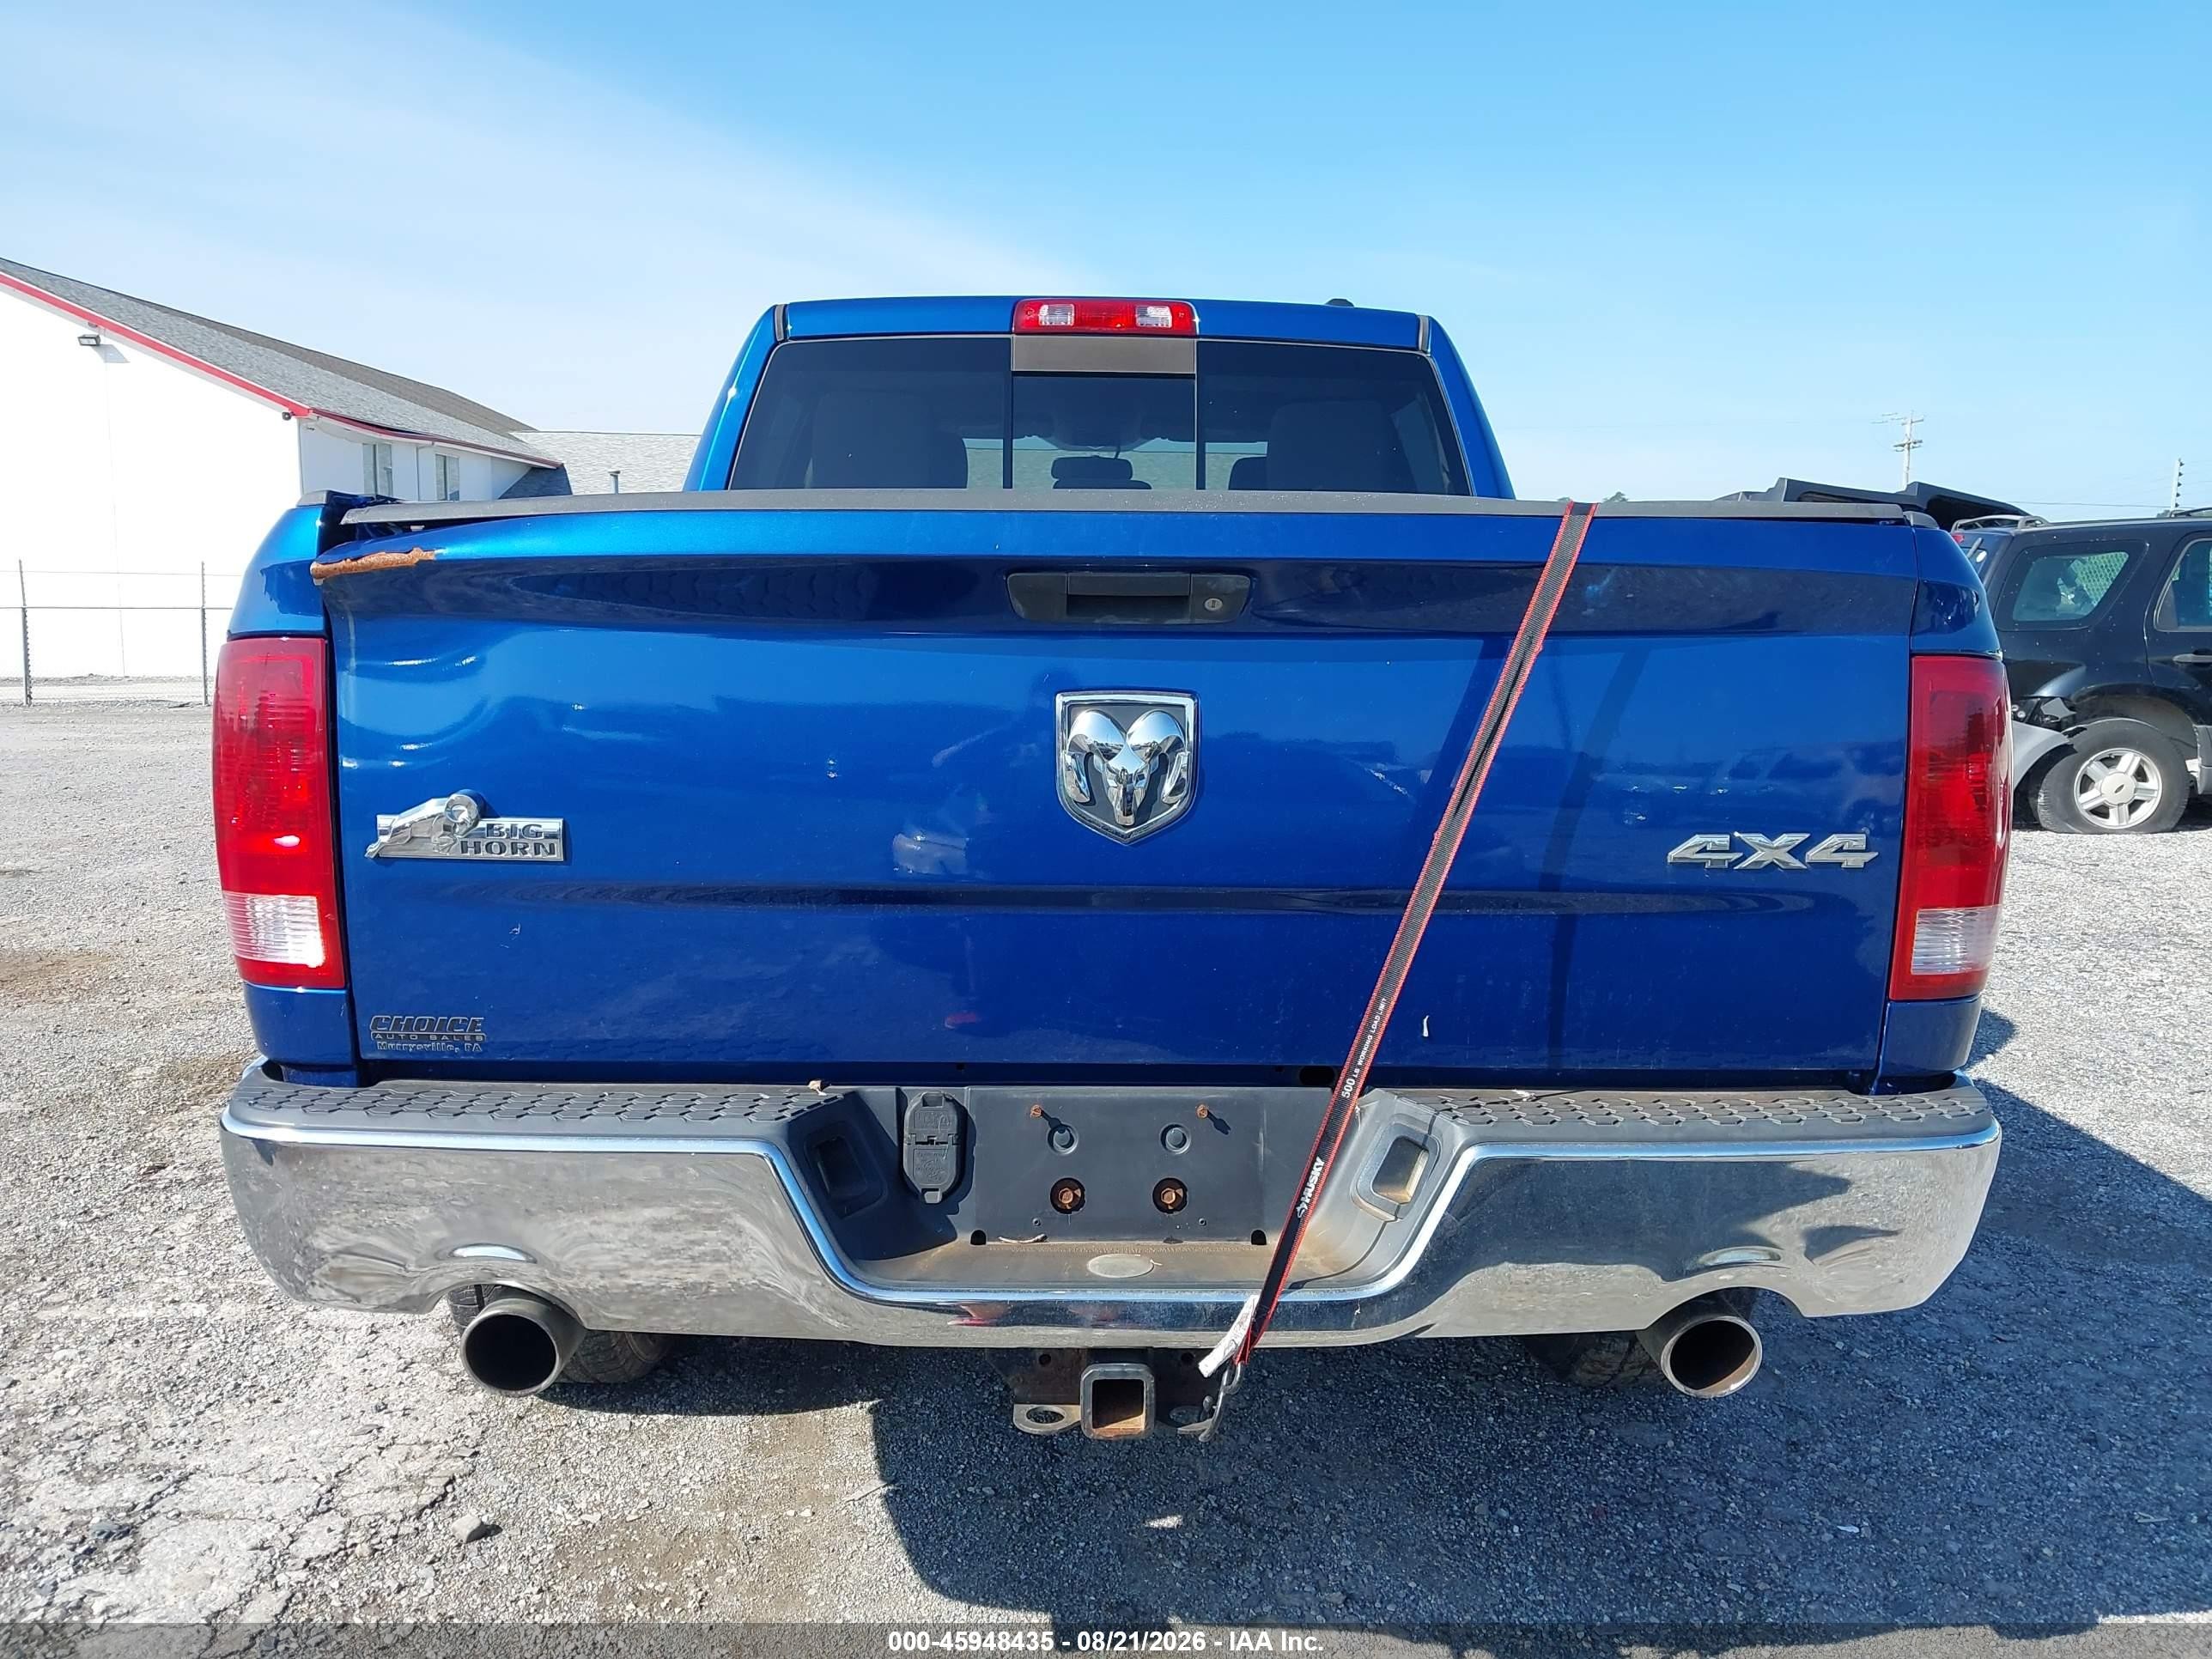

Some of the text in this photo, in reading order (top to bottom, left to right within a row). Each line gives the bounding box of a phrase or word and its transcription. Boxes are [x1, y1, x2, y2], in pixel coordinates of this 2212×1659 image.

[486, 822, 544, 840] BIG
[459, 841, 556, 857] HORN
[1667, 831, 1879, 870] 4X4
[369, 1015, 484, 1032] CHOICE
[464, 1042, 483, 1052] PA
[1341, 1078, 1356, 1098] 500
[1352, 1068, 1360, 1079] LB
[1357, 1035, 1373, 1066] WORKING
[1369, 1015, 1381, 1034] LOAD
[1300, 1155, 1325, 1204] HUSKY
